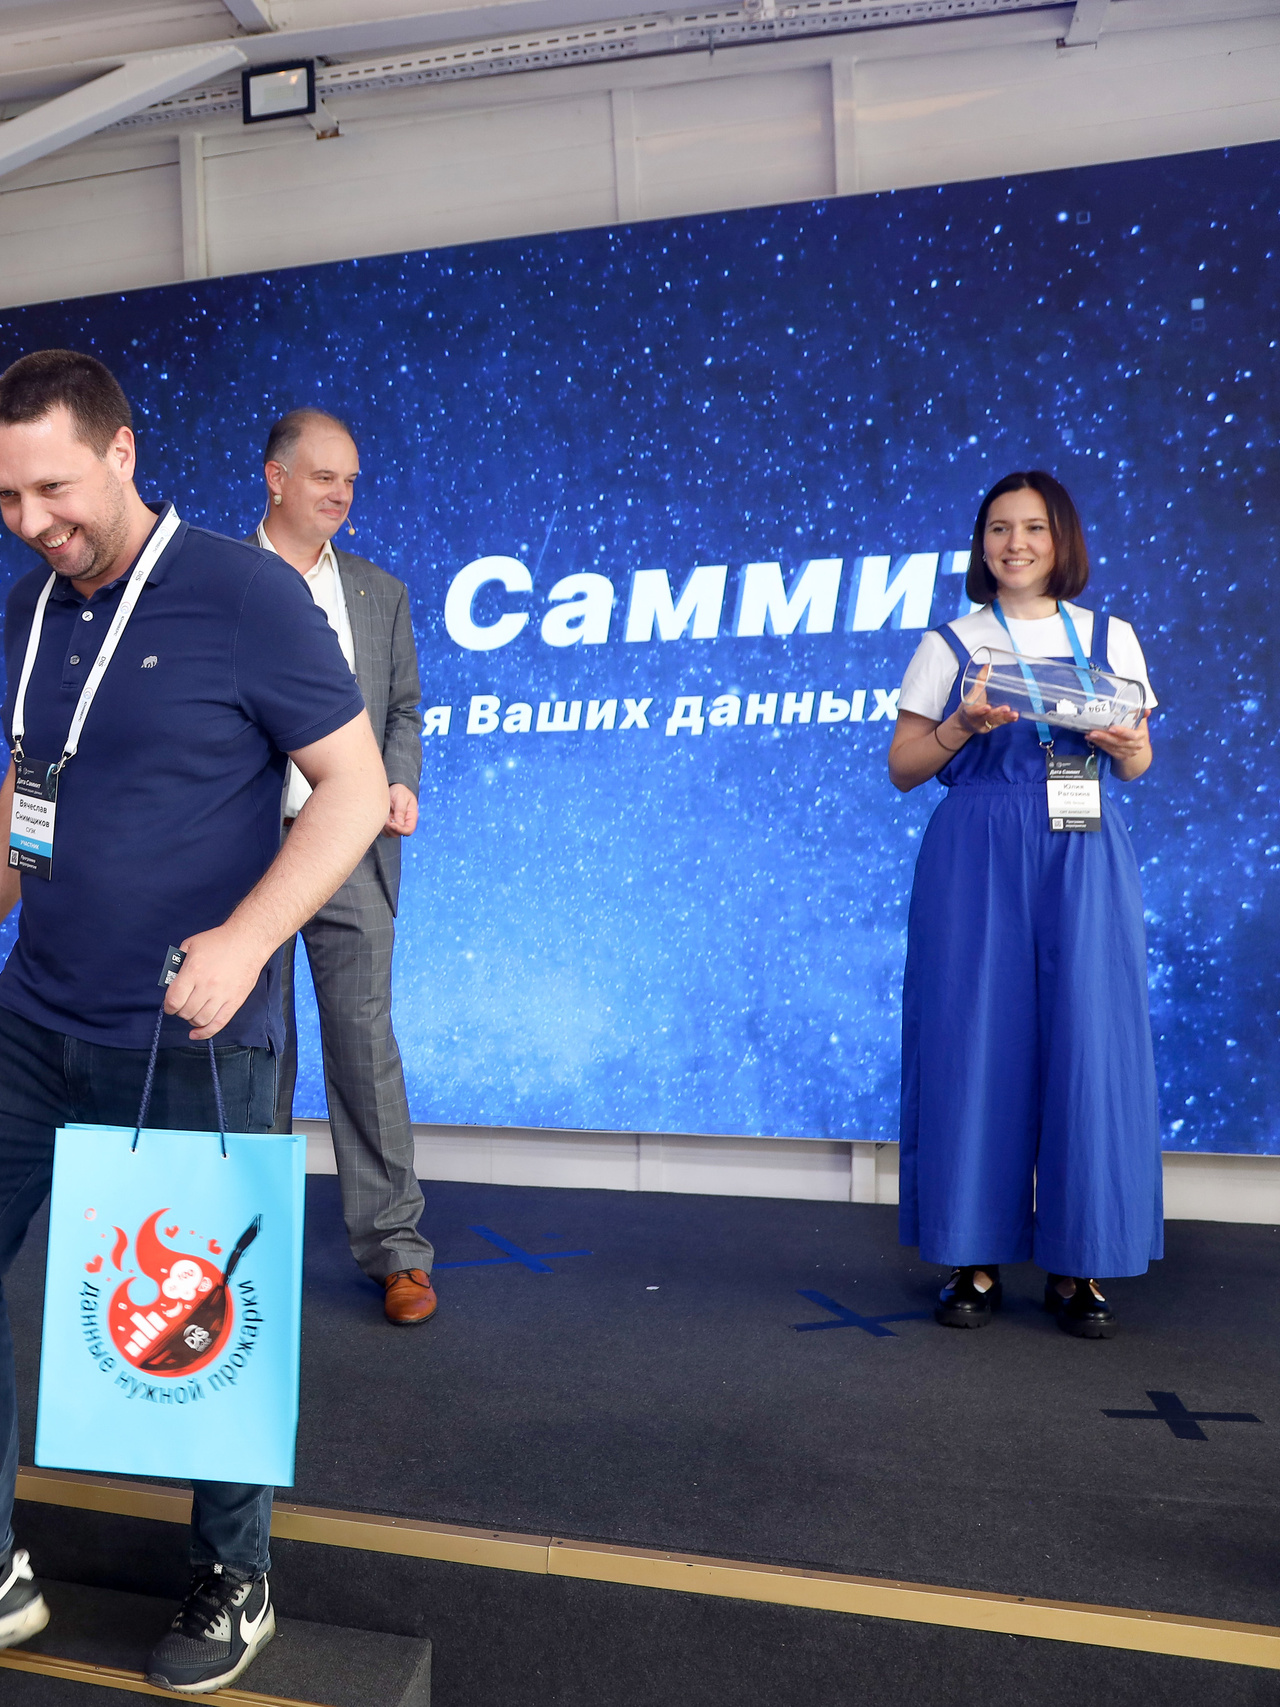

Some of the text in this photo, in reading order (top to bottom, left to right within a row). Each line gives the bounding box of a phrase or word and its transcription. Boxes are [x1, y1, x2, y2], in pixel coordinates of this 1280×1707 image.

[466, 695, 653, 734] Ваших
[665, 688, 901, 736] данных
[19, 799, 48, 814] Вячеслав
[20, 840, 40, 850] УЧАСТНИК
[79, 1280, 265, 1404] данные нужной прожарки
